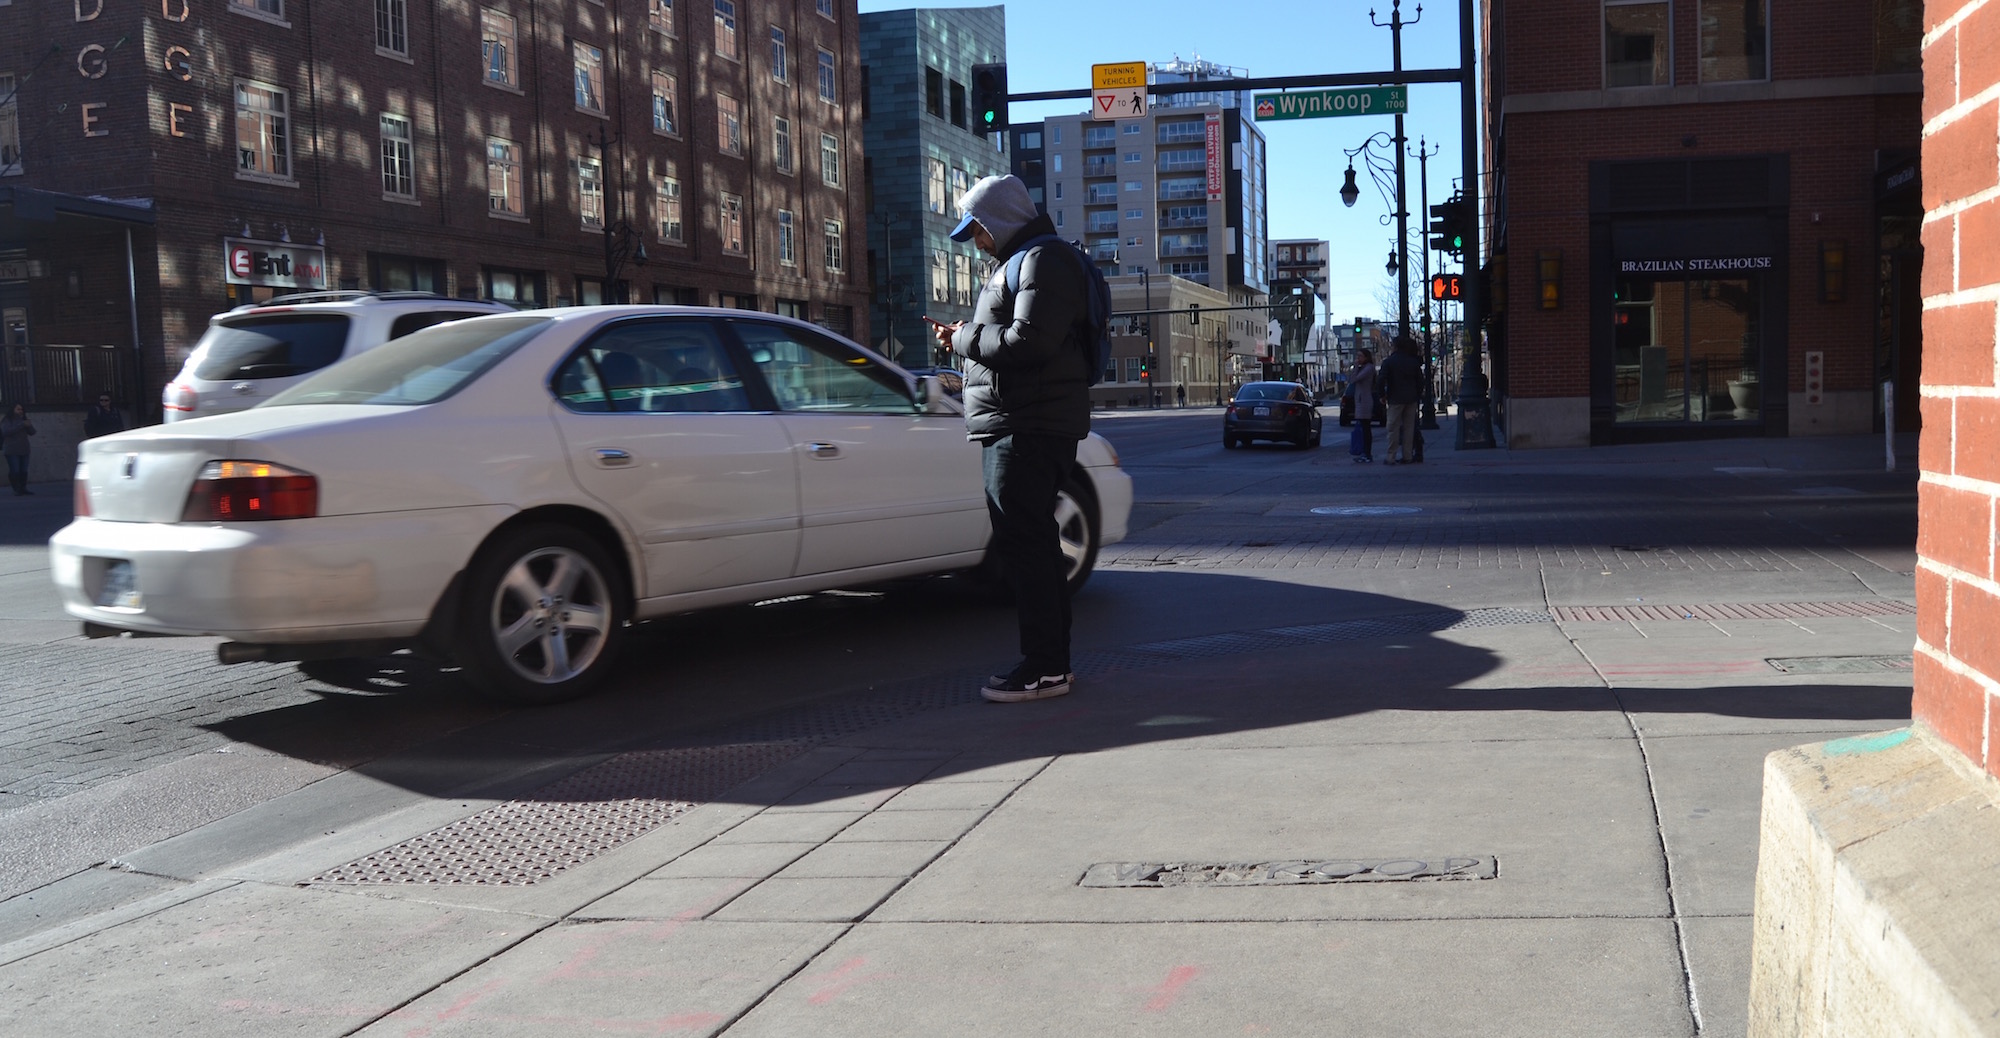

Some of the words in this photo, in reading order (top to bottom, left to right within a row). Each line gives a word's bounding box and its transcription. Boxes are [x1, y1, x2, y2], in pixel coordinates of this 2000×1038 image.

[1104, 67, 1135, 75] TURNING
[1102, 77, 1137, 85] VEHICLES
[1279, 92, 1372, 117] Wynkoop
[1390, 91, 1400, 100] St
[1385, 100, 1405, 109] 1700
[254, 252, 291, 276] Ent
[294, 264, 320, 278] ATM
[1621, 260, 1684, 271] BRAZILIAN
[1688, 257, 1772, 270] STEAKHOUSE
[1451, 278, 1459, 296] 6
[1113, 857, 1480, 881] WKOOP
